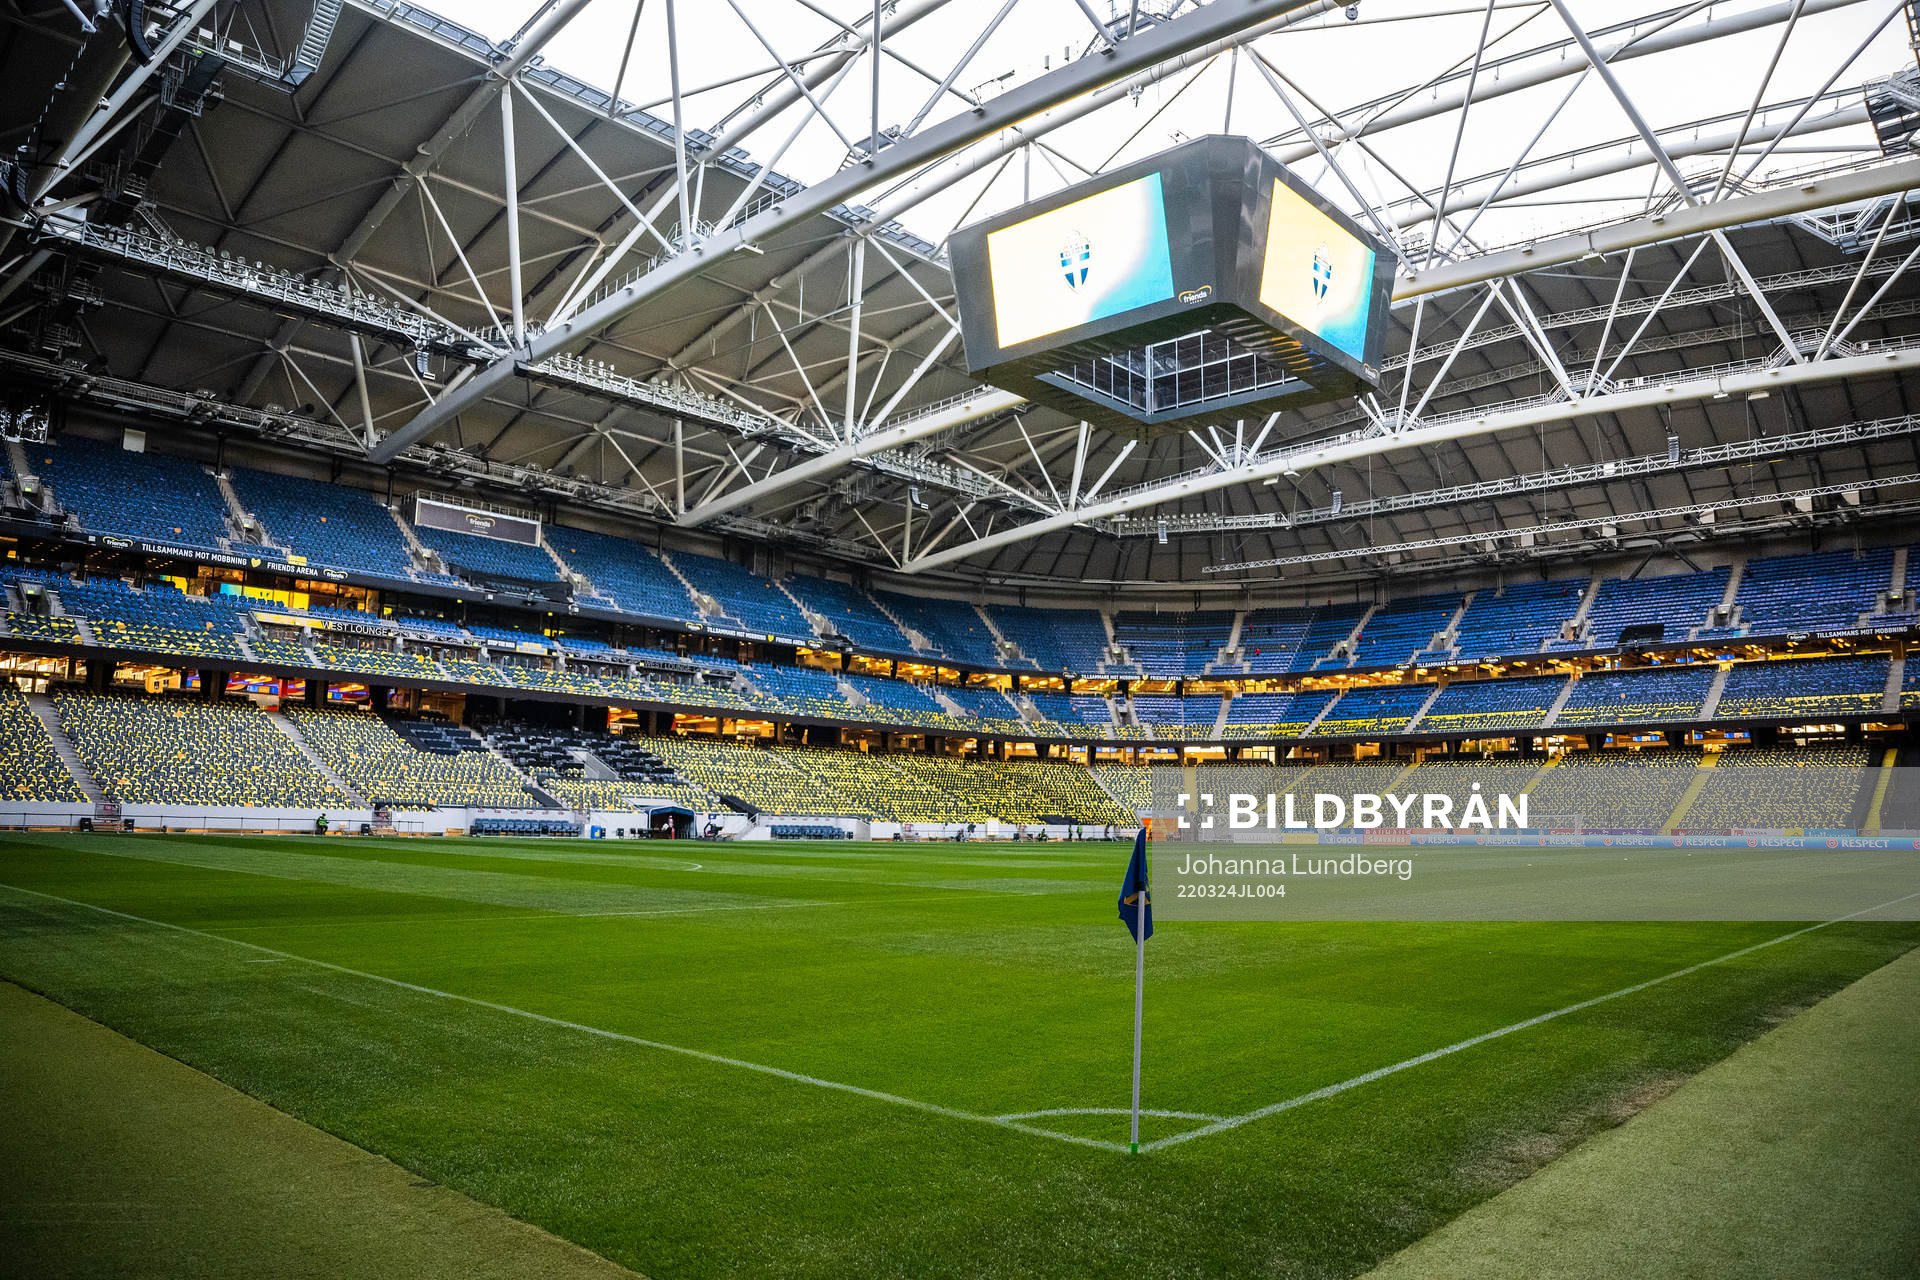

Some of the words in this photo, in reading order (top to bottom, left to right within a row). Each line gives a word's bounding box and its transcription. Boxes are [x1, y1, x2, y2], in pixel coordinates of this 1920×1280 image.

[1183, 291, 1208, 303] friends
[142, 543, 193, 558] TILLSAMMANS
[195, 551, 210, 560] MOT
[211, 554, 247, 566] MOBBNING
[267, 561, 295, 573] FRIENDS
[296, 566, 318, 577] ARENA
[321, 620, 348, 632] WEST
[350, 623, 388, 636] LOUNGE
[1817, 629, 1860, 639] TILLSAMMANS
[1860, 628, 1873, 636] MOT
[1874, 626, 1908, 634] MOBBNING
[1428, 836, 1460, 844] RESPECT
[1488, 836, 1521, 845] RESPECT
[1550, 836, 1585, 845] RESPECT
[1616, 836, 1654, 846] RESPECT
[1686, 837, 1727, 847] RESPECT
[1761, 838, 1805, 847] RESPECT
[1842, 839, 1890, 848] RESPECT
